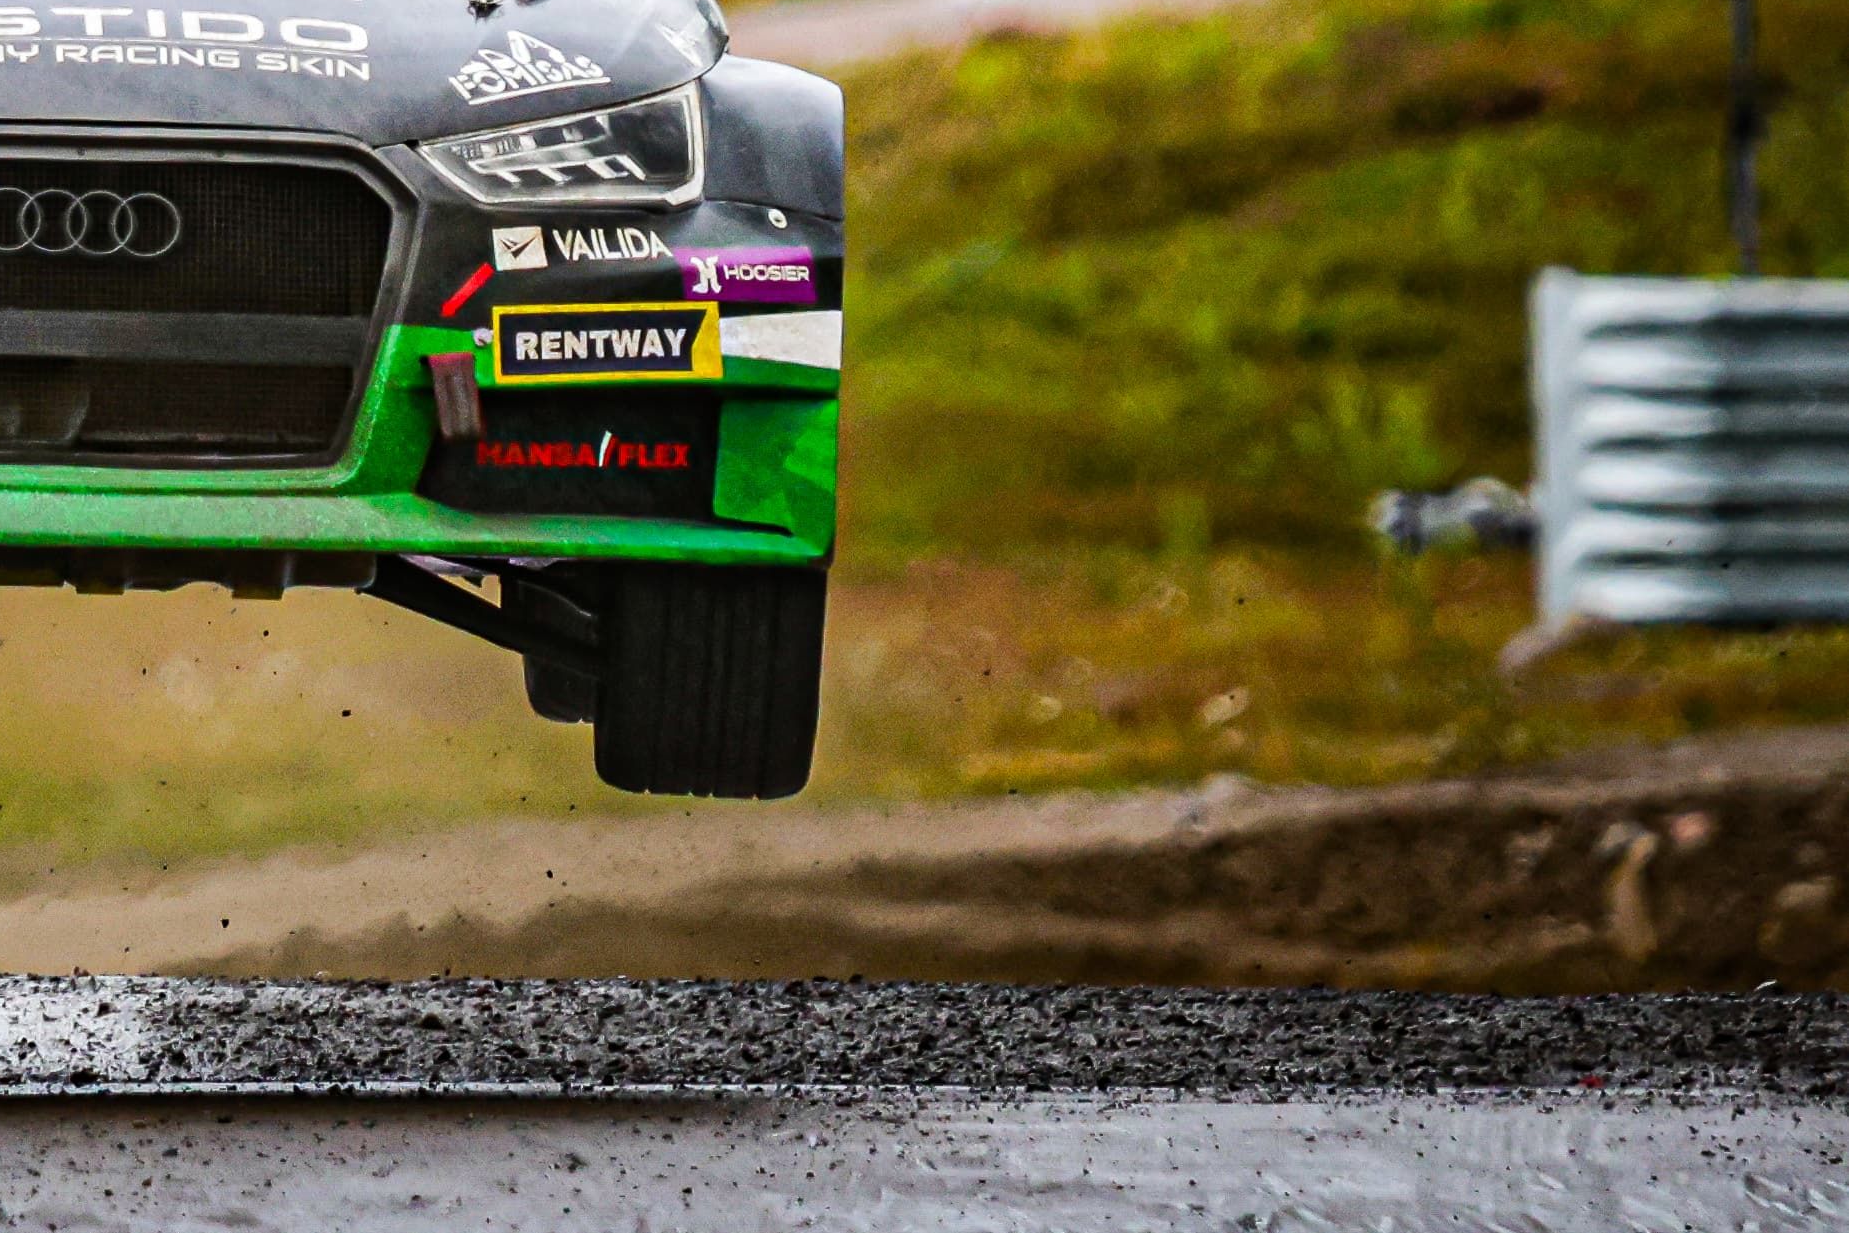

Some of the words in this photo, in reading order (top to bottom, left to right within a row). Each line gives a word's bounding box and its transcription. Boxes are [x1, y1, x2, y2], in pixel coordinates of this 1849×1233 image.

[56, 44, 240, 69] RACING
[257, 52, 369, 80] SKIN
[552, 228, 674, 262] VAILIDA
[724, 263, 810, 282] HOOSIER
[516, 328, 687, 361] RENTWAY
